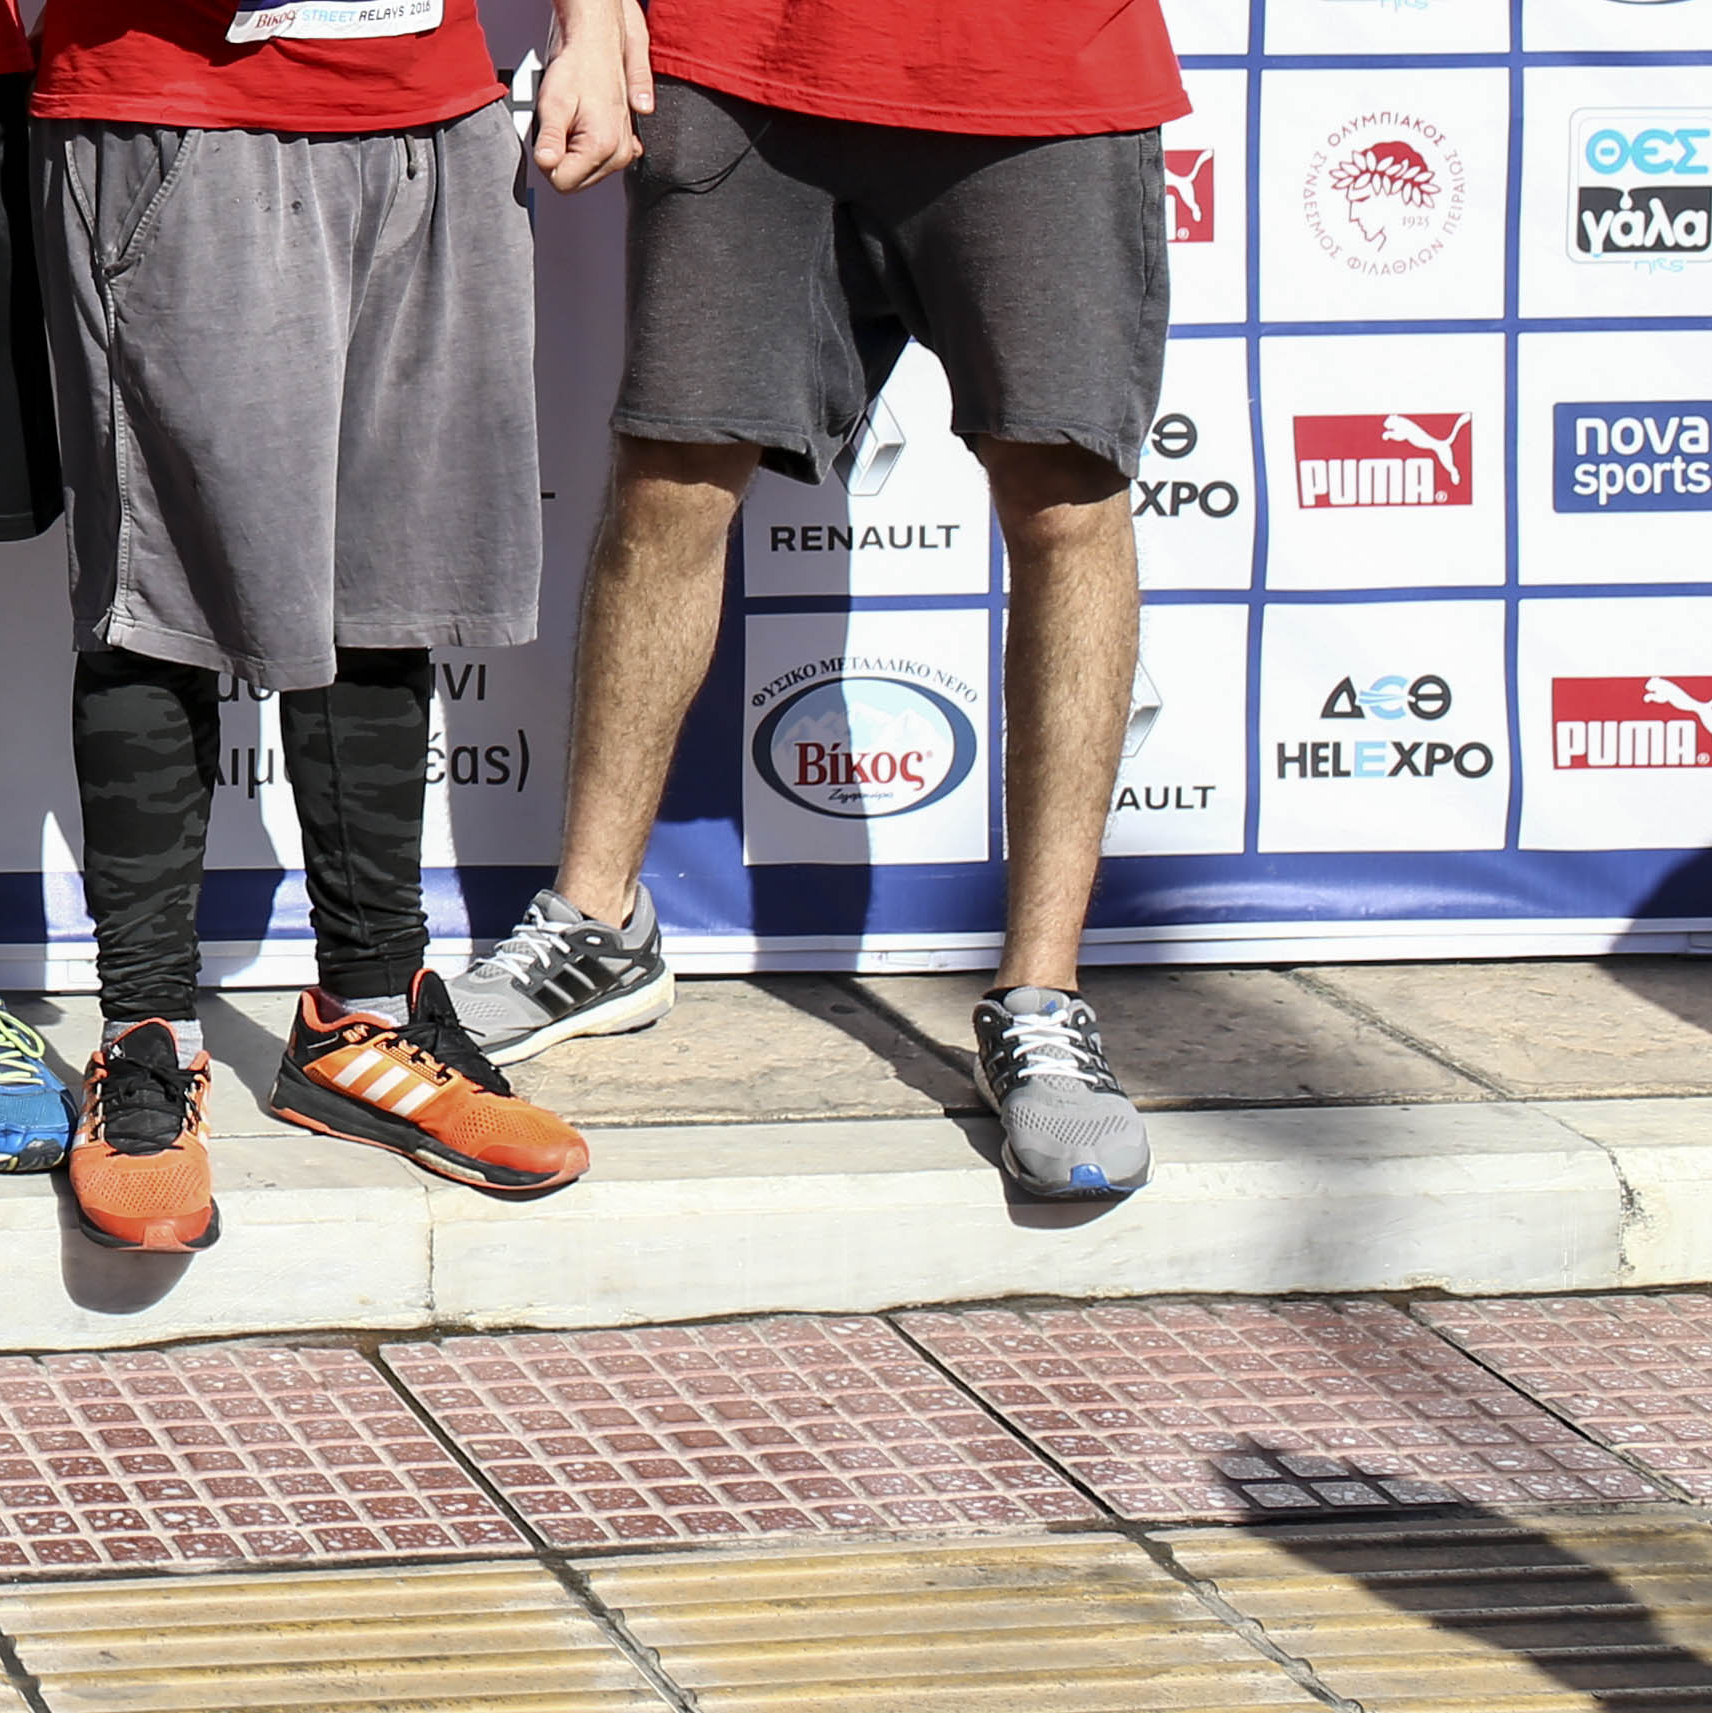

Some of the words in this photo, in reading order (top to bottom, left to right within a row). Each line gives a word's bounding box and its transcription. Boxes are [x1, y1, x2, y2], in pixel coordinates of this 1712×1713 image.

[358, 4, 405, 22] RELAYS
[1327, 109, 1447, 148] ΟΛΥΜΠΙΑΚΟΣ
[1585, 128, 1711, 175] ΘΕΣ
[1400, 214, 1432, 229] 1925
[1581, 196, 1711, 258] γάλα
[1575, 416, 1710, 456] nova
[1298, 458, 1438, 506] PUMA
[770, 524, 961, 552] RENAULT
[751, 660, 818, 709] ΦΥΣΙΚΟ
[819, 656, 932, 679] ΜΕΤΑΛΛΙΚΟ
[933, 668, 978, 705] ΝΕΡΟ
[1277, 741, 1494, 780] HELEXPO
[1556, 720, 1699, 768] PUMA
[794, 741, 925, 791] Βίκος
